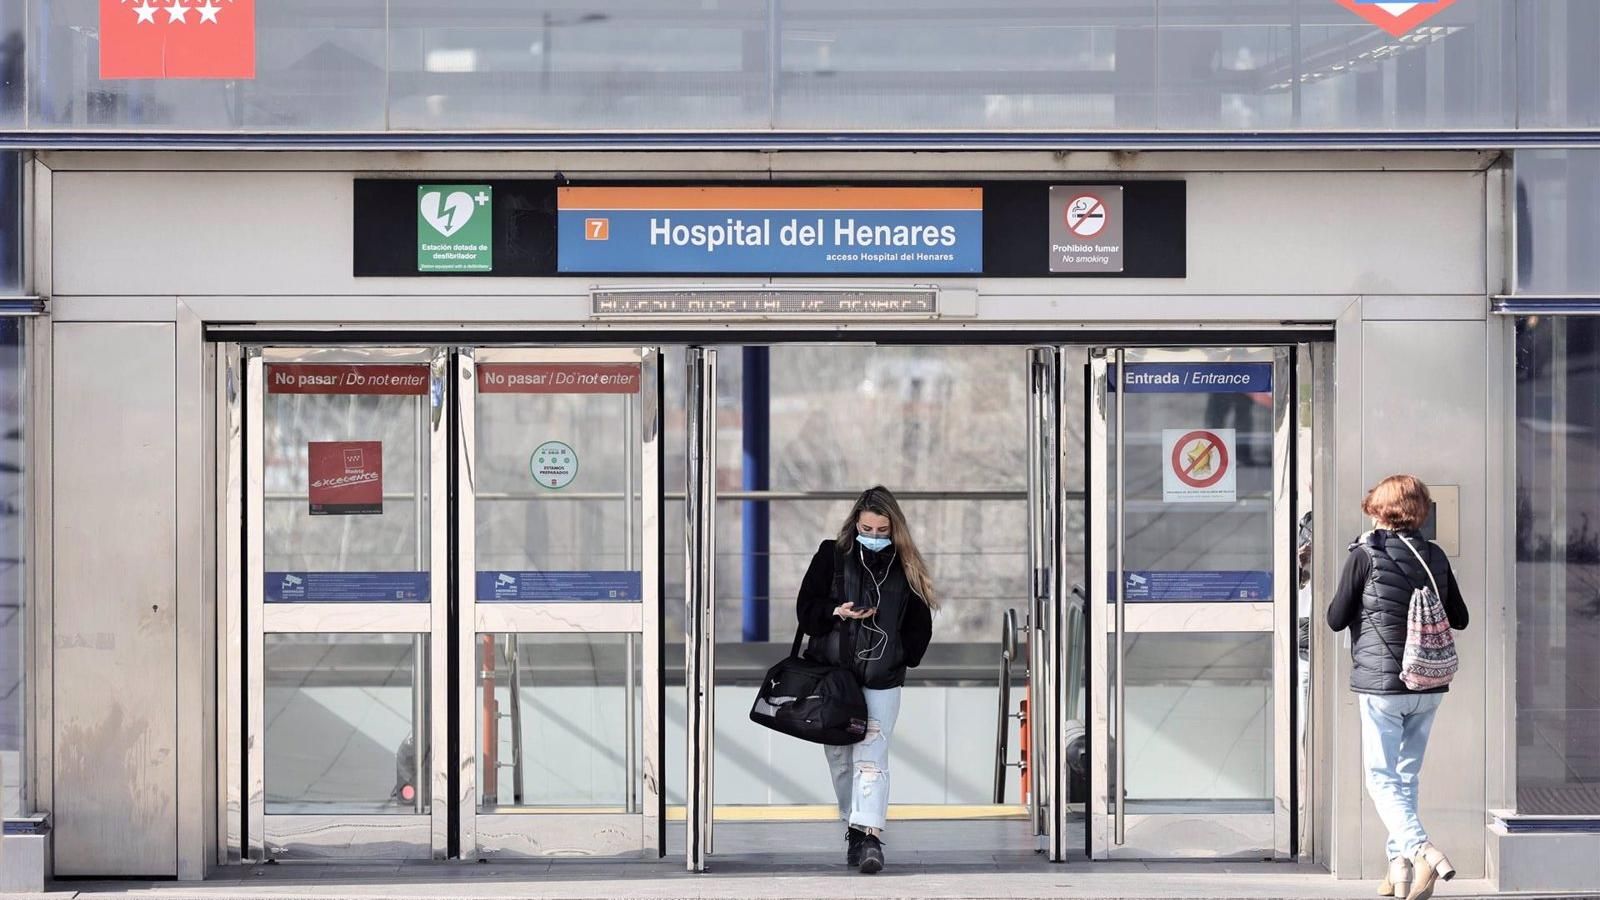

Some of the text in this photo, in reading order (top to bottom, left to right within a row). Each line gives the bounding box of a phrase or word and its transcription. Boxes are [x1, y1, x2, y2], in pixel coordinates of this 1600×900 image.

[590, 218, 956, 252] 7 Hospital del Henares
[421, 243, 488, 251] Estación dotada de
[1052, 244, 1119, 253] Prohibido fumar
[432, 252, 477, 260] desfibrilador
[826, 252, 954, 264] acceso Hospital del Henares
[1062, 255, 1109, 265] No smoking
[275, 372, 295, 385] No
[298, 374, 338, 387] pasar
[346, 373, 364, 385] Do
[368, 374, 390, 386] not
[391, 374, 425, 386] enter
[485, 372, 505, 385] No
[508, 374, 546, 387] pasar
[555, 372, 574, 385] Do
[577, 373, 600, 385] not
[600, 374, 634, 385] enter
[1125, 372, 1179, 384] Entrada
[1191, 372, 1250, 384] Entrance
